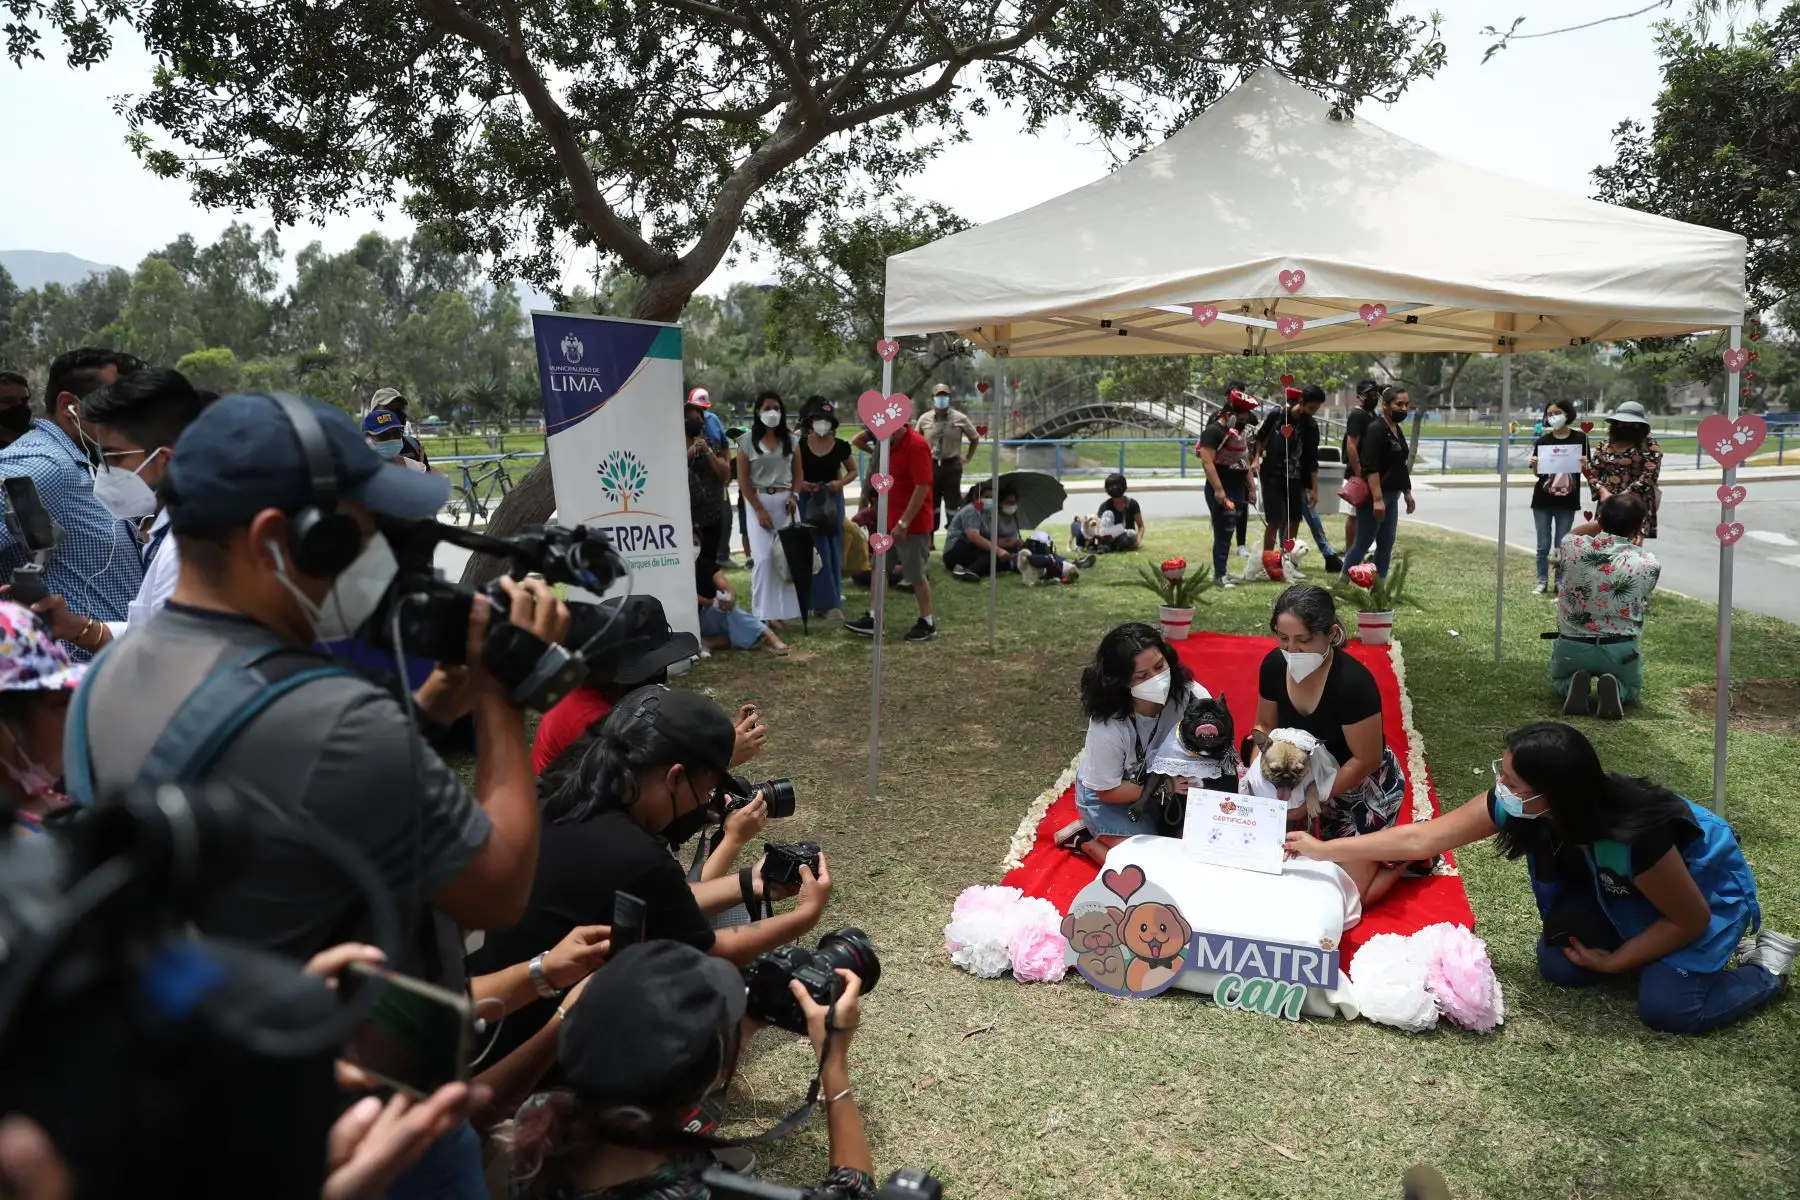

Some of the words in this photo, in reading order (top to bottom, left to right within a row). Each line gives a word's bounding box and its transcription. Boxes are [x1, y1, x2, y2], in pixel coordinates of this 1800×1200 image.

[550, 375, 603, 393] LIMA
[652, 557, 660, 567] de
[660, 556, 680, 567] Lima
[1212, 814, 1257, 827] CERTIFICADO
[1197, 936, 1330, 985] MATRI
[1214, 974, 1306, 1020] can
